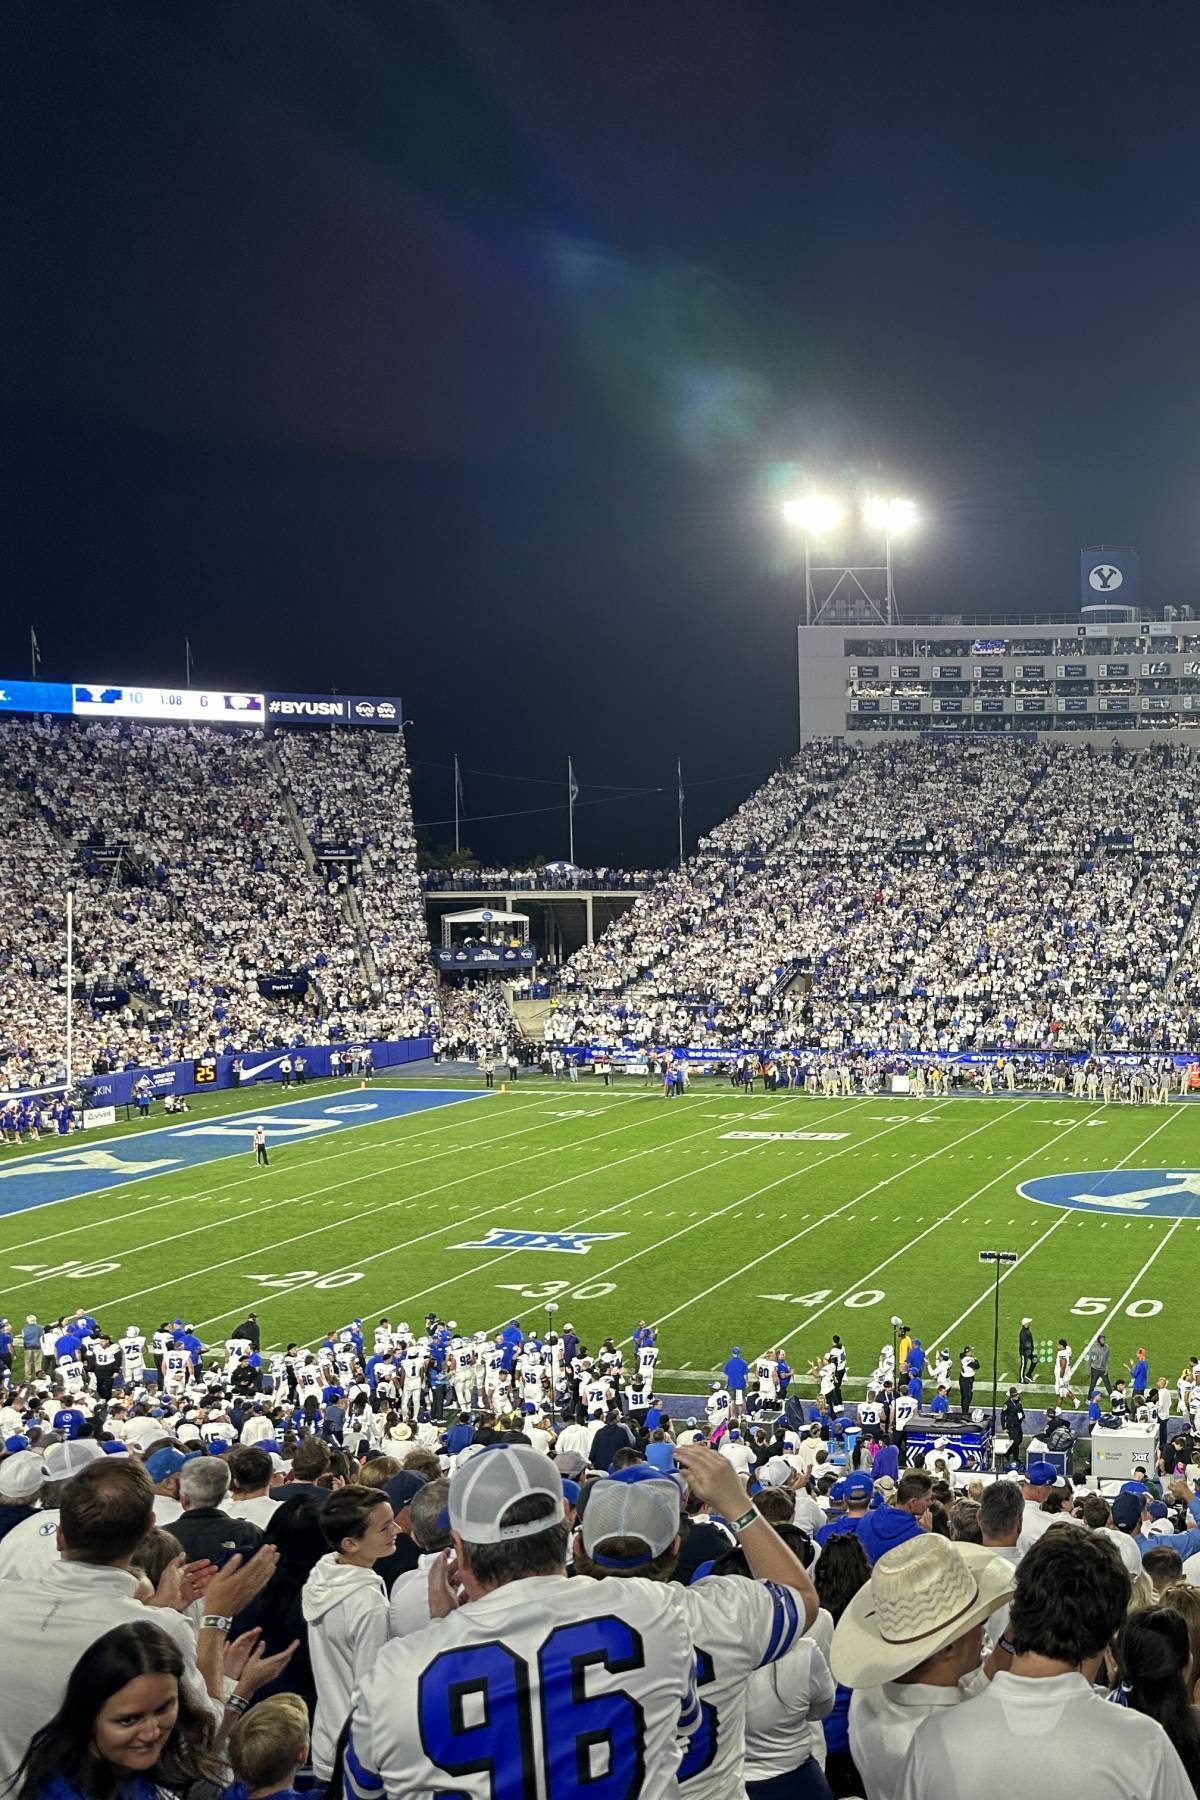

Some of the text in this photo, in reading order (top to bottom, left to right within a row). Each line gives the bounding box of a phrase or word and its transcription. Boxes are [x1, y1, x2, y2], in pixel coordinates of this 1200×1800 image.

[1095, 566, 1117, 589] Y
[129, 692, 143, 704] 10
[161, 694, 182, 705] 1:08
[268, 701, 344, 716] #BYUSN
[196, 1066, 215, 1082] 25
[94, 1086, 112, 1096] SKIN
[94, 1110, 112, 1119] vivint
[885, 1115, 942, 1123] 30
[1050, 1118, 1109, 1127] 40
[33, 1260, 122, 1278] 10
[258, 1270, 366, 1288] 20
[522, 1280, 618, 1300] 30
[792, 1289, 886, 1308] 40
[1070, 1296, 1164, 1318] 50
[125, 1345, 140, 1354] 75
[229, 1347, 242, 1356] 74
[97, 1354, 108, 1363] 51
[168, 1358, 182, 1369] 63
[460, 1354, 472, 1366] 92
[489, 1358, 501, 1369] 42
[642, 1355, 654, 1366] 17
[67, 1368, 82, 1378] 50
[411, 1366, 416, 1376] 1
[758, 1367, 769, 1378] 80
[524, 1372, 537, 1384] 56
[589, 1390, 604, 1402] 72
[631, 1393, 644, 1405] 91
[716, 1398, 728, 1410] 96
[862, 1411, 876, 1423] 73
[898, 1407, 912, 1419] 77
[417, 1614, 647, 1800] 96
